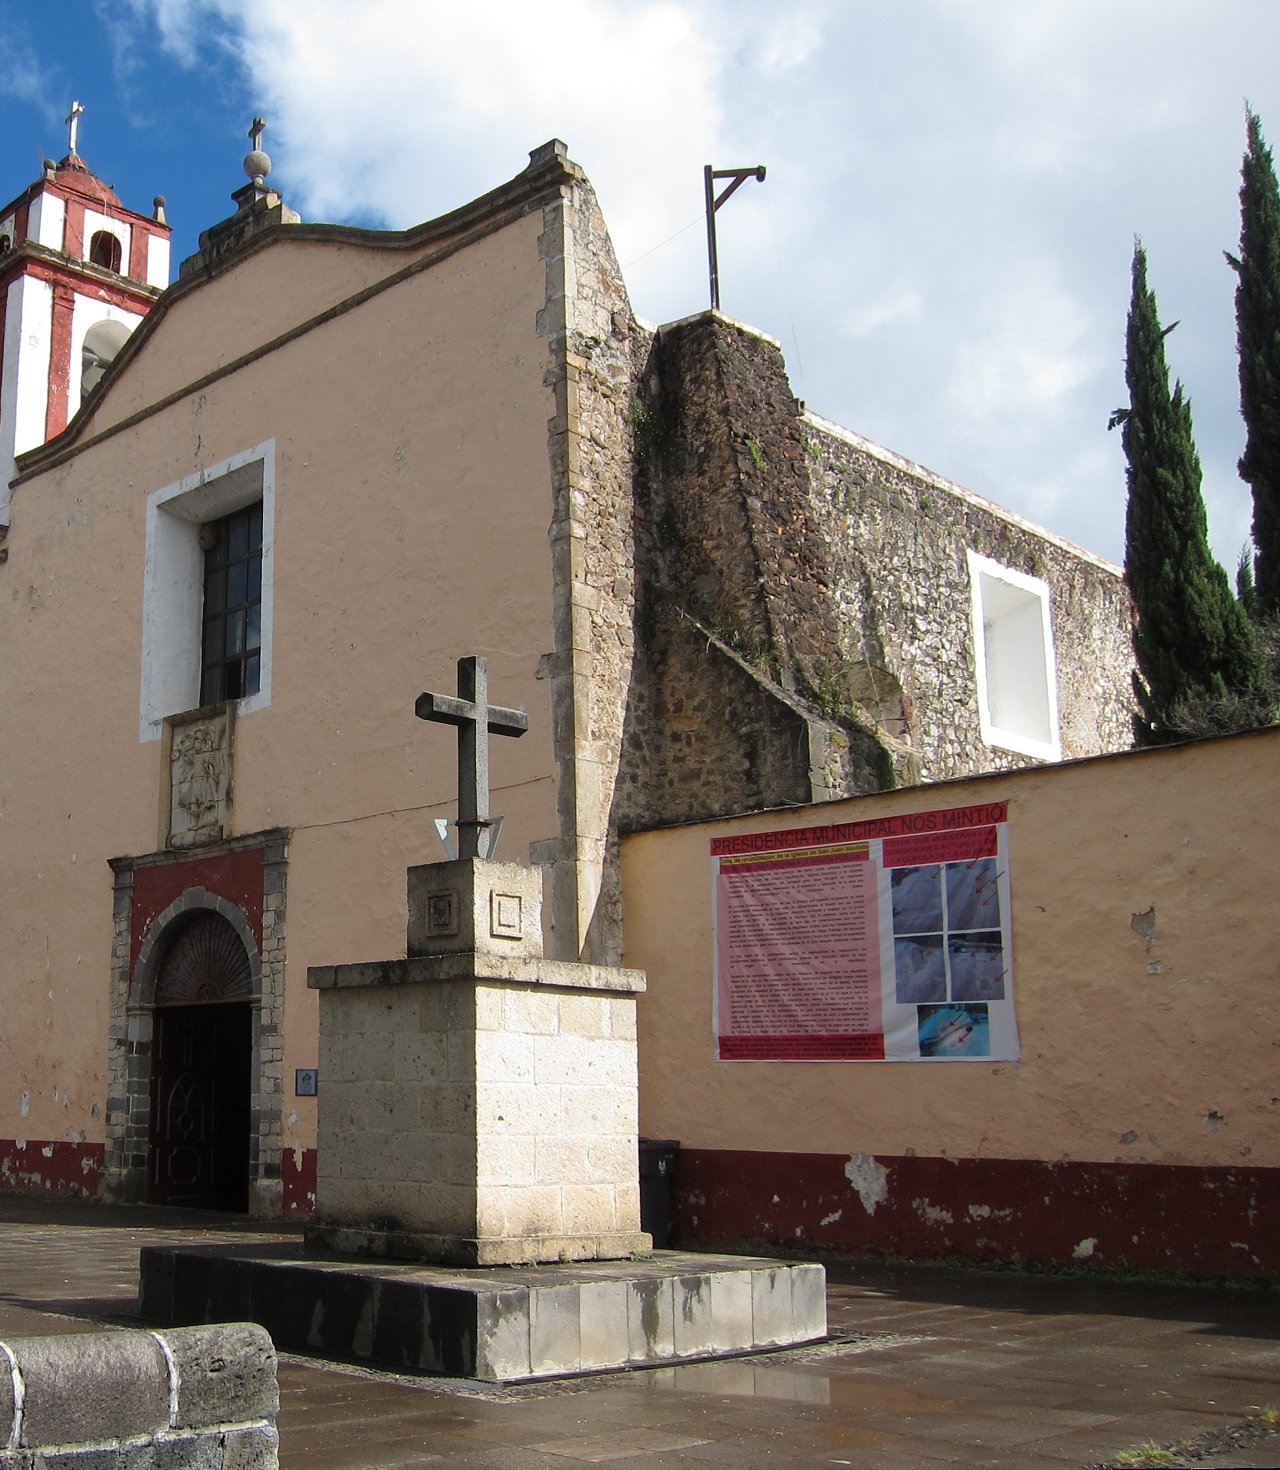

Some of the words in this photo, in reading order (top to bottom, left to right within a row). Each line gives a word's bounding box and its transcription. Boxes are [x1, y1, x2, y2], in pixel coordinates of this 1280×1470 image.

[713, 832, 808, 853] PRESIDENCIA
[812, 822, 896, 842] MUNICIPAL
[901, 814, 936, 832] NOS
